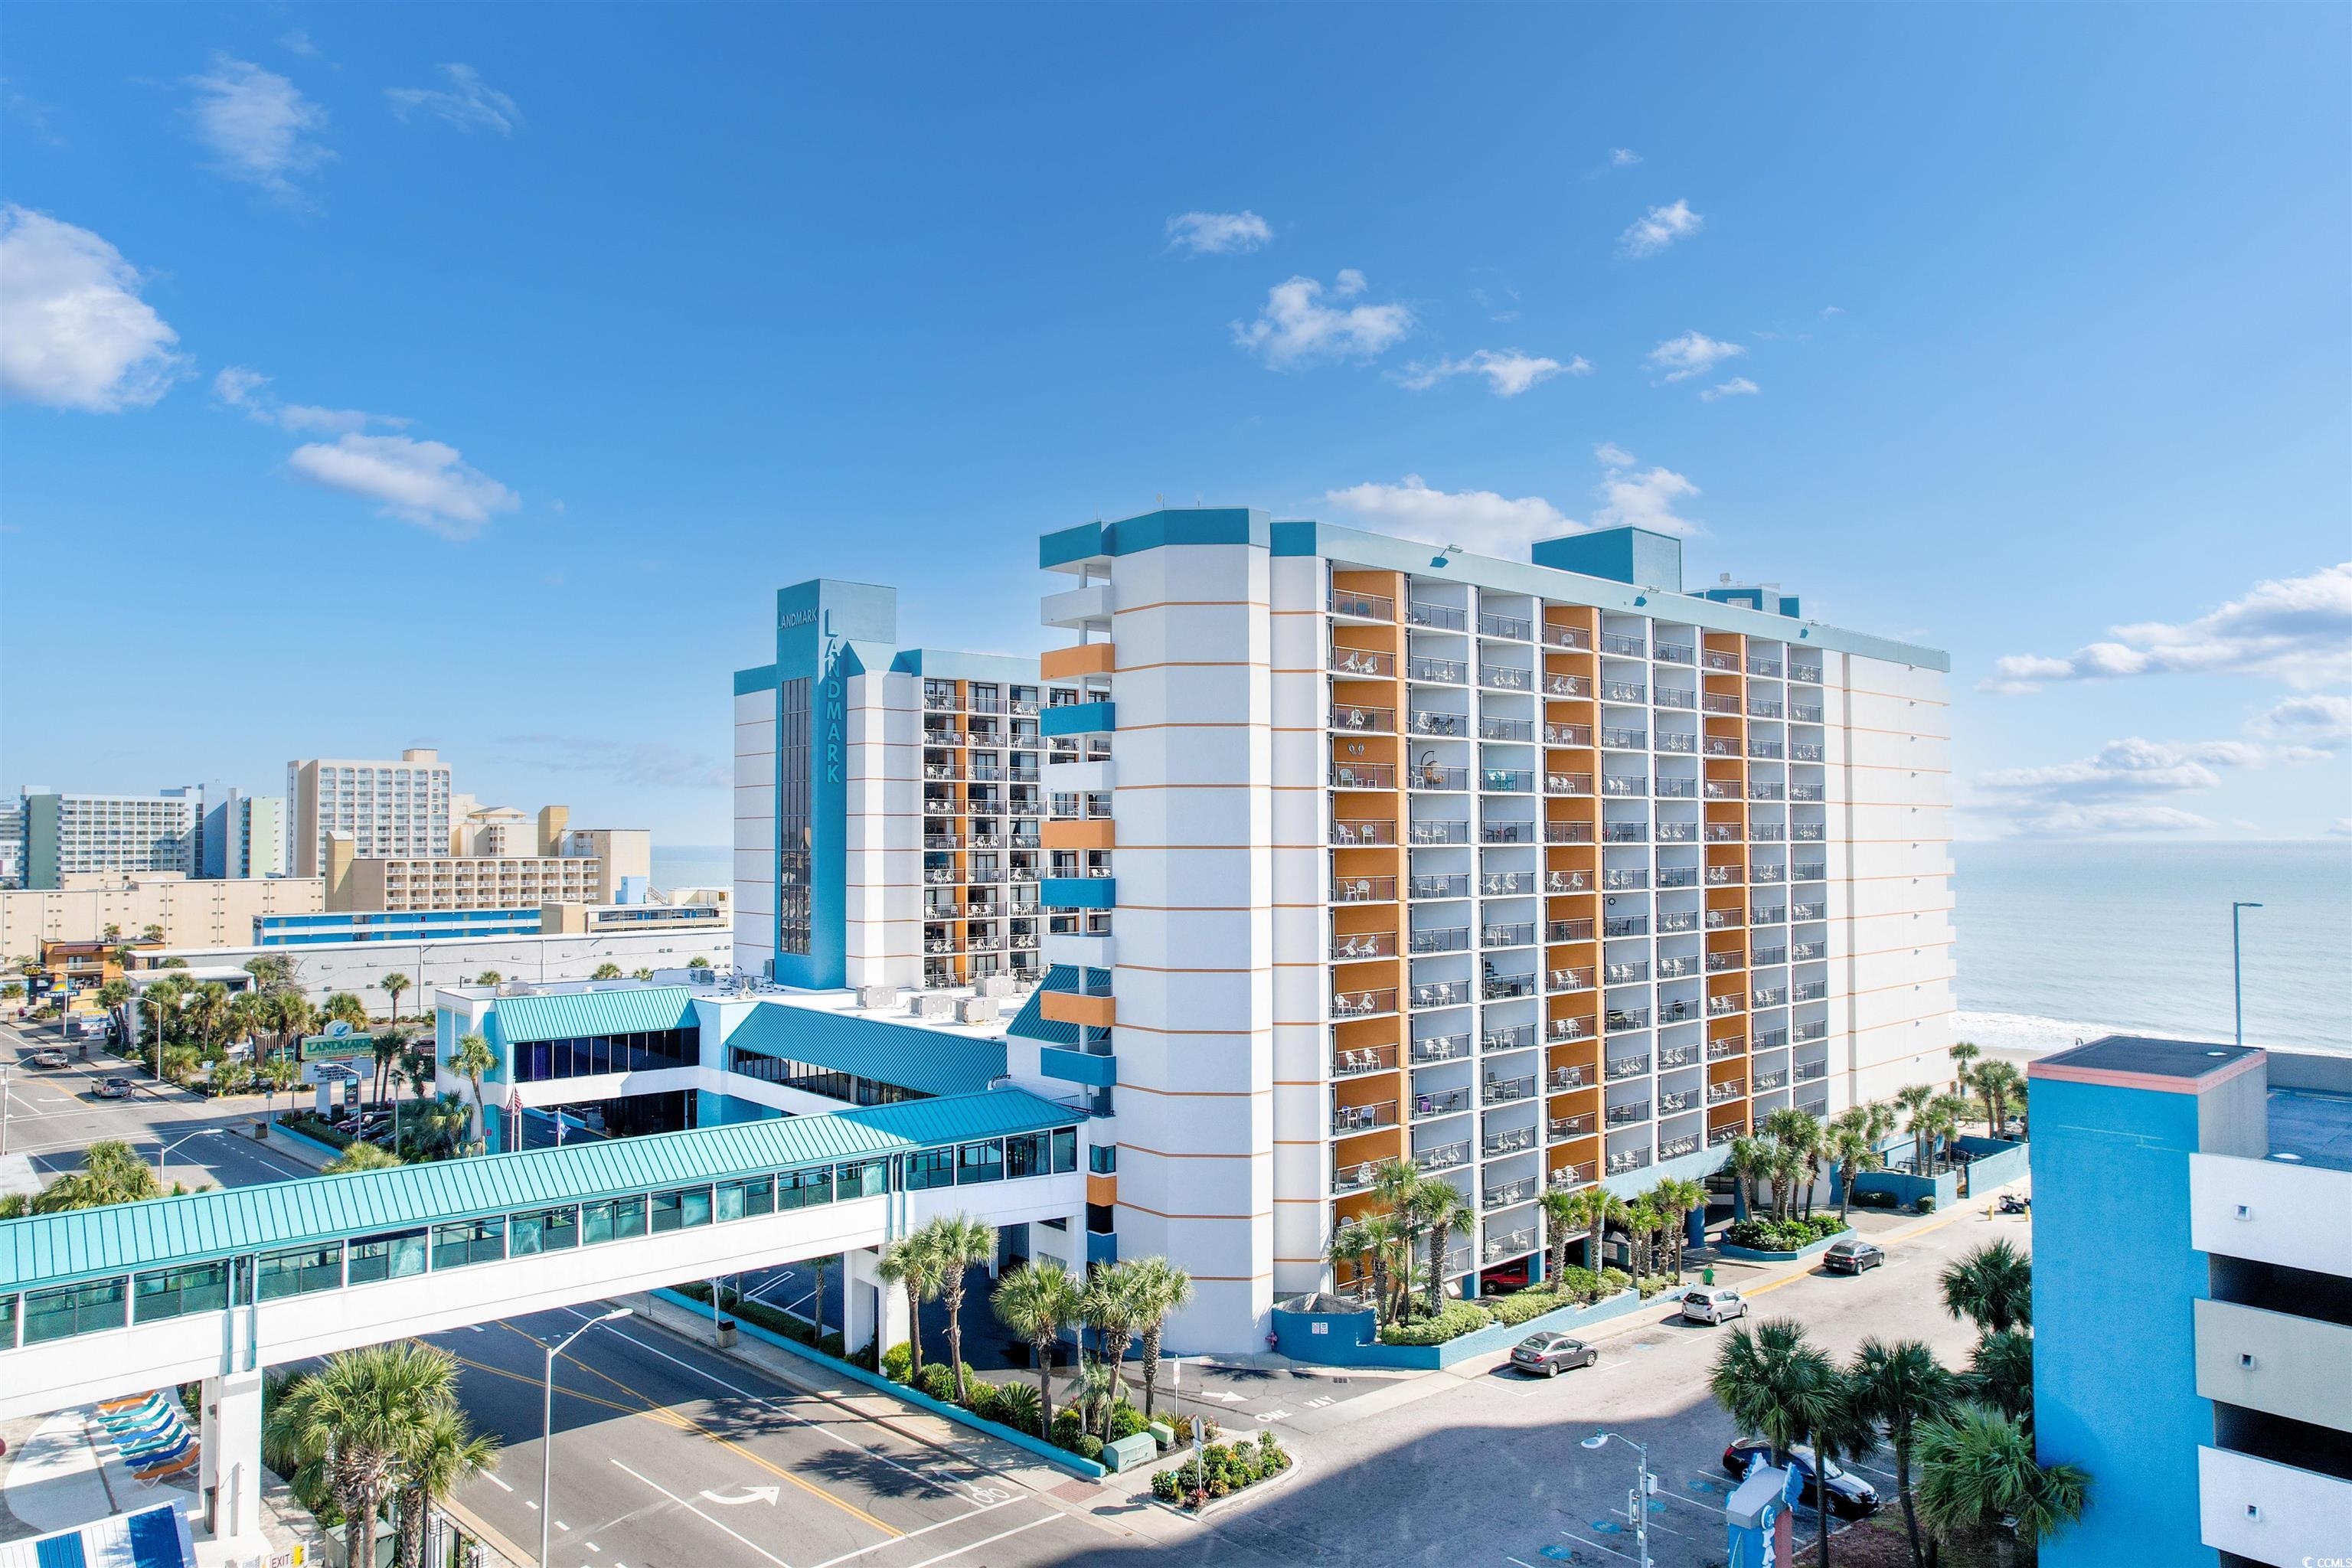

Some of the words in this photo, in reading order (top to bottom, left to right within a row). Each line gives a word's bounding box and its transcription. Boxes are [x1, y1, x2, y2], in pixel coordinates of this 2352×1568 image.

[779, 607, 818, 629] LANDMARK
[825, 609, 841, 784] LANDMARK
[307, 1038, 373, 1052] LANDMARK
[1254, 1410, 1293, 1422] ONE
[1303, 1395, 1336, 1408] WAY
[1762, 1527, 1776, 1568] PA
[271, 1553, 290, 1568] EXIT
